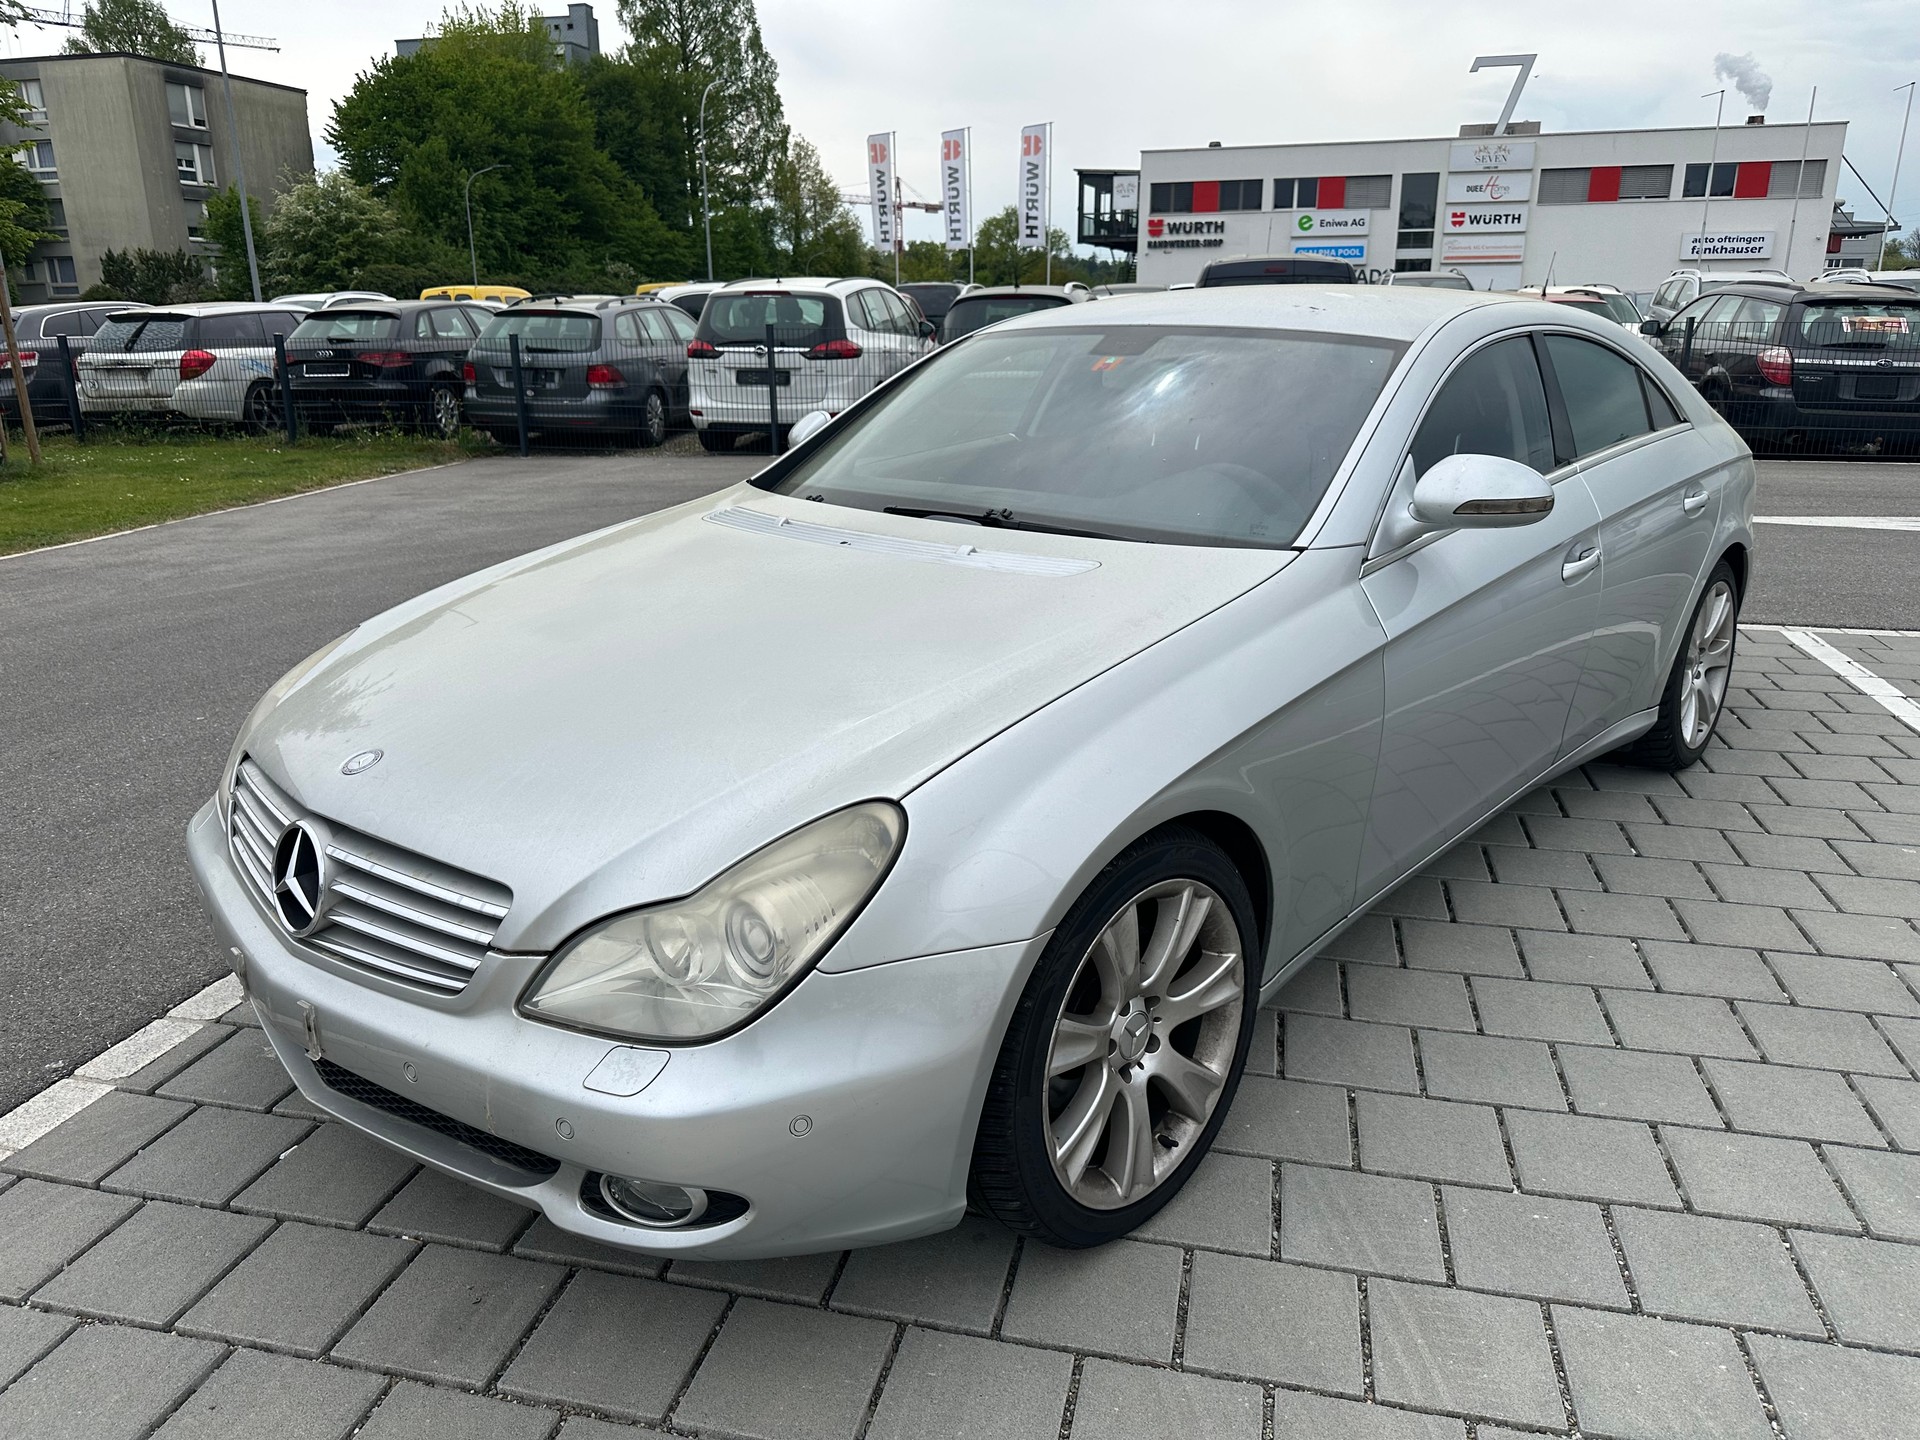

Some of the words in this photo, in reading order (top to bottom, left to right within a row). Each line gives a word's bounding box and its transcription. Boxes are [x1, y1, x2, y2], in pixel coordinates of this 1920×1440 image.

[1469, 53, 1537, 136] 7
[1475, 154, 1508, 163] SEVEN
[1466, 184, 1484, 193] DUEE
[1319, 219, 1348, 228] Eniwa
[1350, 218, 1365, 227] AG
[1469, 213, 1521, 225] WÜRTH
[1167, 221, 1225, 235] WÜRTH
[1147, 239, 1224, 249] HANDWERKER-SHOP
[1717, 235, 1765, 245] oftringen
[1338, 248, 1361, 256] POOL
